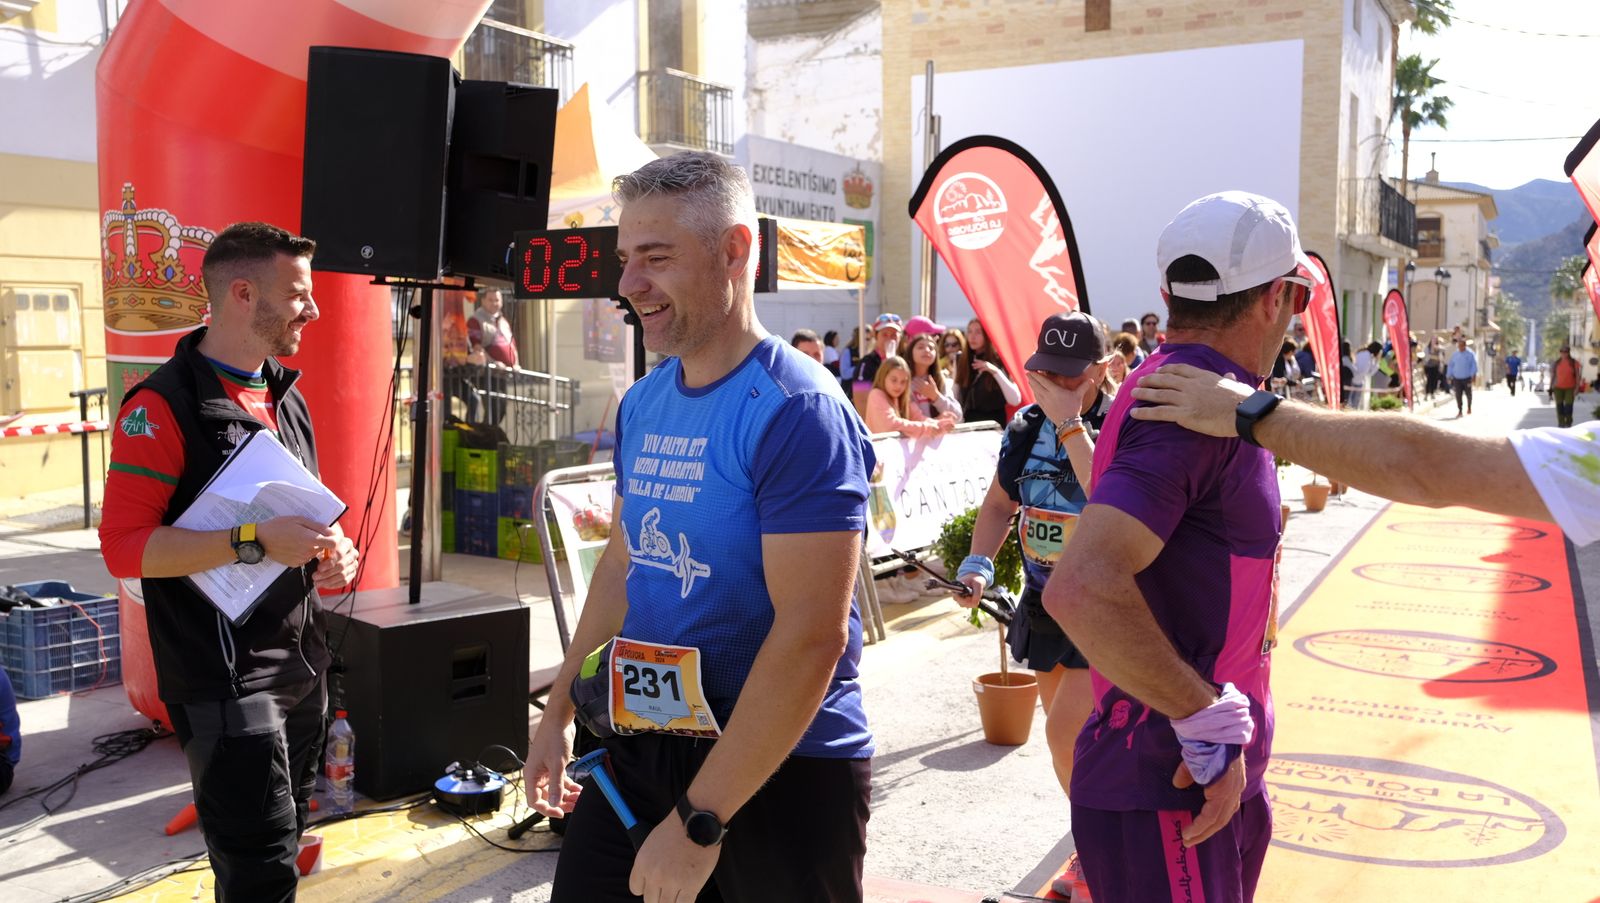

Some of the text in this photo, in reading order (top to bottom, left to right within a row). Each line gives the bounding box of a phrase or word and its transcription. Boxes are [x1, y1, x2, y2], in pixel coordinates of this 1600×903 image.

[753, 164, 837, 195] EXCELENTÍSIMO
[755, 195, 836, 223] AYUNTAMIENTO
[641, 433, 662, 454] XIV
[633, 456, 705, 481] MEDIA MARATÓN
[651, 483, 666, 499] DE
[1027, 520, 1063, 543] 502
[623, 664, 681, 702] 231
[1286, 702, 1513, 734] Ayuntamiento
